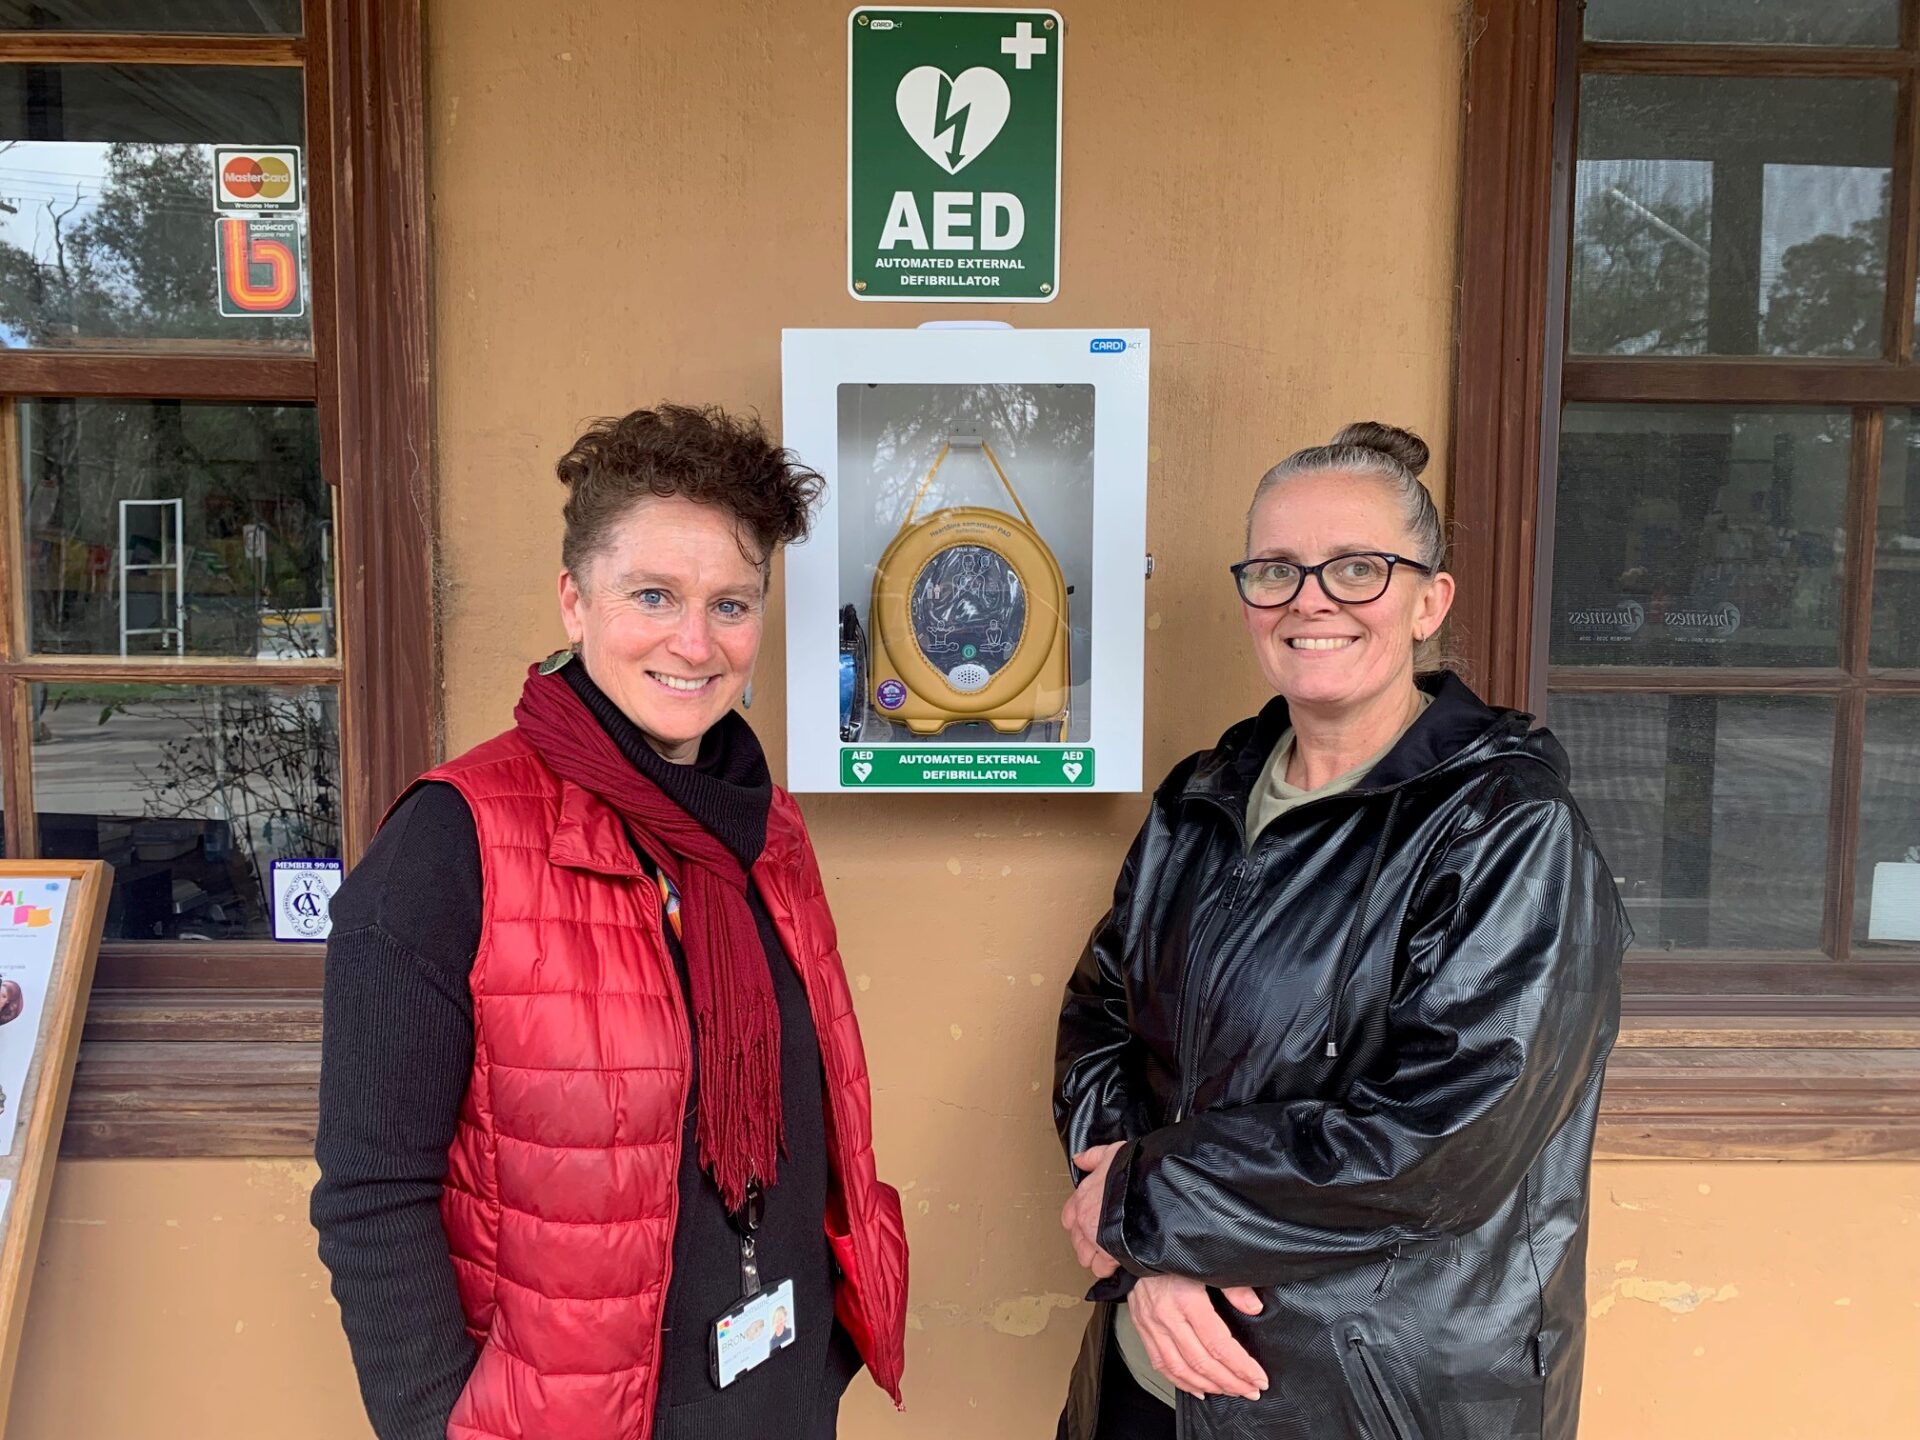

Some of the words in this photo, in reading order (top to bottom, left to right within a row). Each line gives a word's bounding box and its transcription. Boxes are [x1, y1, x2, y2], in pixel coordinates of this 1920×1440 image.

[224, 172, 289, 183] MasterCard
[878, 191, 1025, 250] AED
[250, 223, 294, 231] bankcard
[875, 258, 954, 269] AUTOMATED
[957, 258, 1025, 269] EXTERNAL
[900, 275, 1000, 286] DEFIBRILLATOR
[851, 751, 874, 761] AED
[899, 754, 974, 764] AUTOMATED
[976, 754, 1041, 764] EXTERNAL
[1062, 751, 1084, 761] AED
[922, 770, 1018, 780] DEFIBRILLATOR
[275, 861, 313, 869] MEMBER
[0, 890, 25, 906] AL
